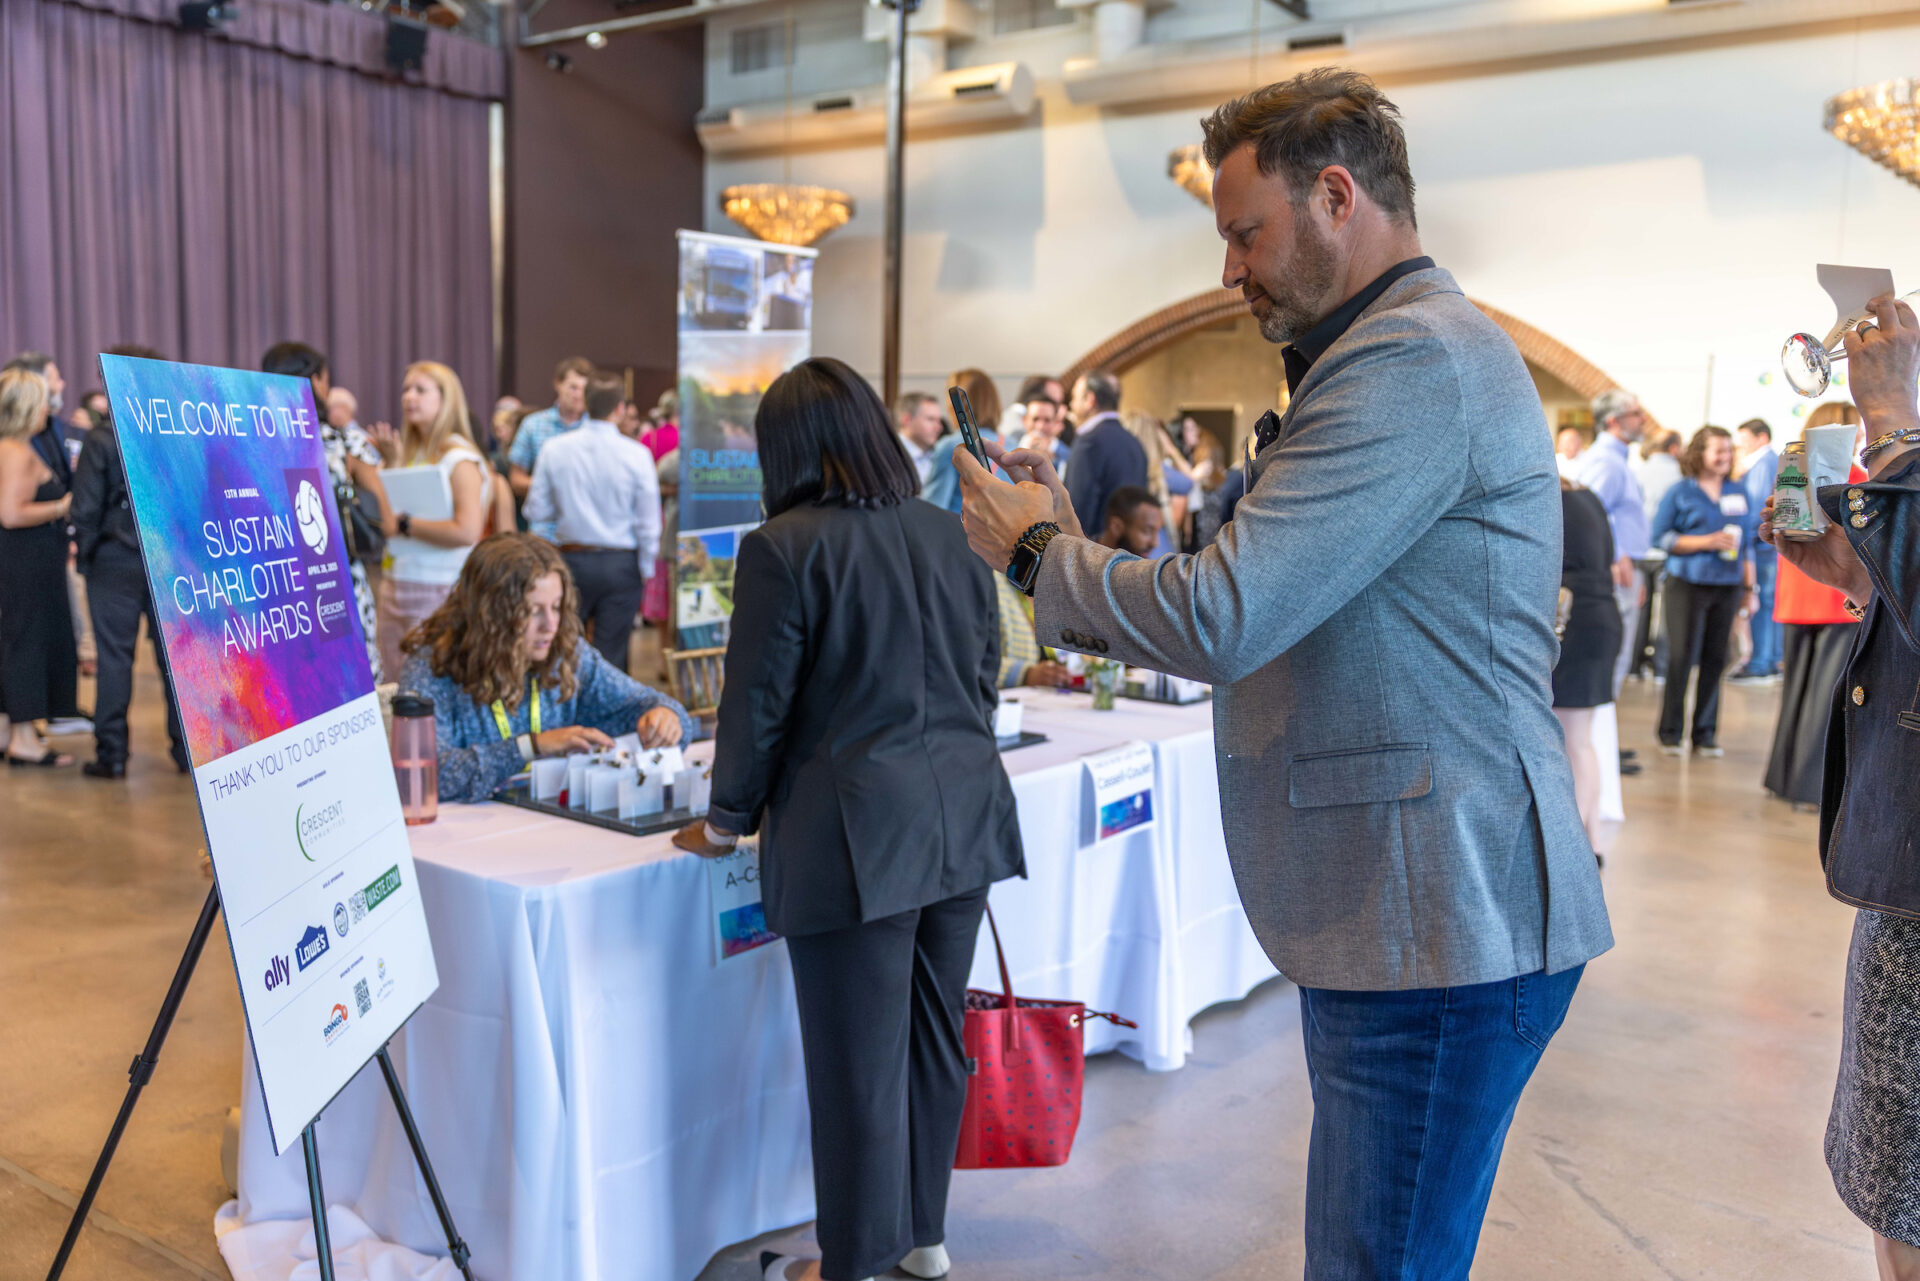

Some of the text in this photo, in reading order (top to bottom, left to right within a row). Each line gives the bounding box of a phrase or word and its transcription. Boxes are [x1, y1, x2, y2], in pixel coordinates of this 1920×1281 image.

[126, 396, 314, 439] WELCOME TO THE
[224, 487, 260, 499] 13TH ANNUAL
[203, 514, 294, 558] SUSTAIN
[173, 557, 305, 615] CHARLOTTE
[224, 601, 312, 657] AWARDS
[209, 708, 377, 801] THANK YOU TO OUR SPONSORS
[301, 799, 344, 837] CRESCENT
[366, 868, 400, 906] WASTE.COM
[264, 932, 327, 992] ally LOWE'S
